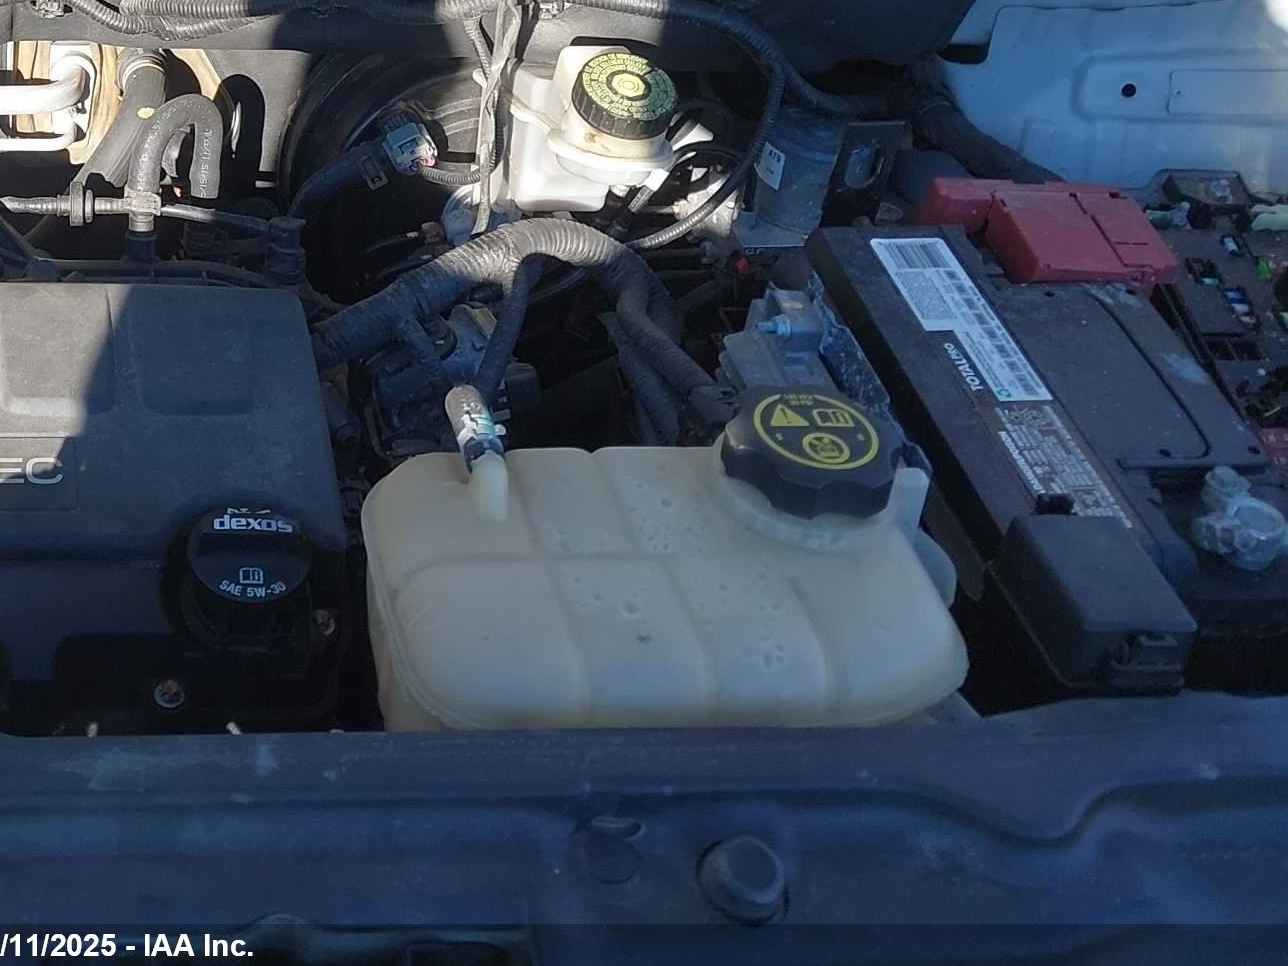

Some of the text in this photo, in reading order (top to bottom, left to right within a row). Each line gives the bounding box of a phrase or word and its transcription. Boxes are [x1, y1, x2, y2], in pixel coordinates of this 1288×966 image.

[213, 514, 293, 533] dexos
[219, 579, 287, 598] SAE 5W-30
